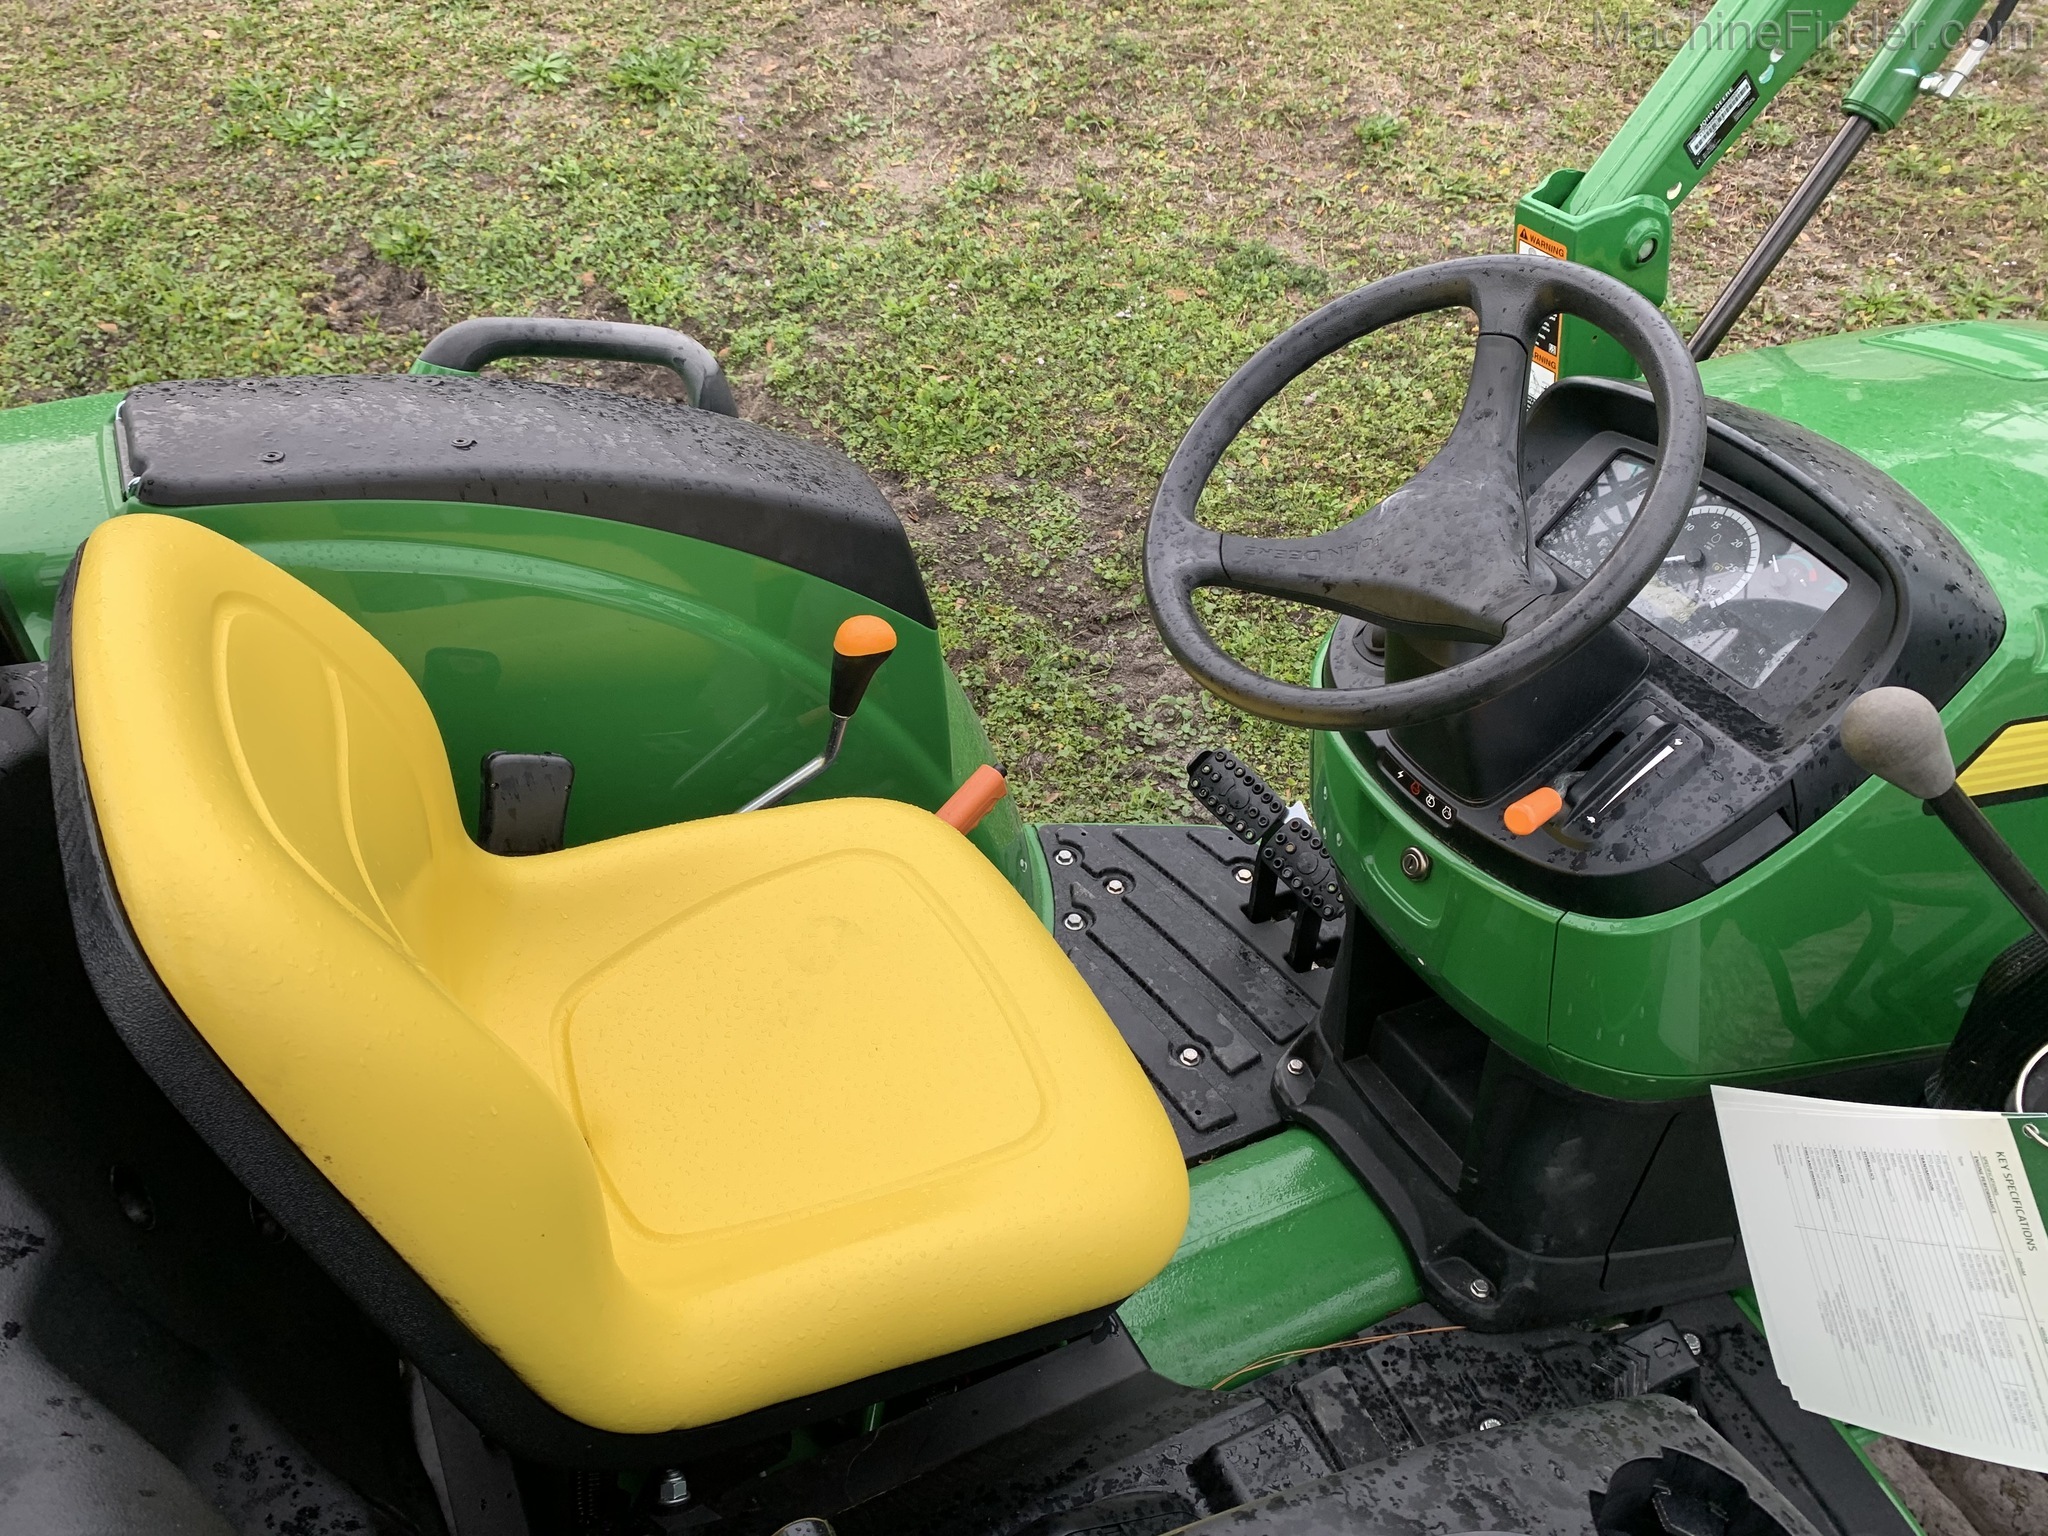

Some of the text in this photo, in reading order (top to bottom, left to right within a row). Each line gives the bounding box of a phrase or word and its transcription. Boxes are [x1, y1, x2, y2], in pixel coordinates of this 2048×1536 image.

[1700, 110, 1715, 129] JOHN
[1715, 87, 1734, 110] DEERE
[1530, 234, 1565, 258] WARNING
[1534, 351, 1556, 370] RNING
[1684, 523, 1695, 532] 10
[1710, 521, 1721, 530] 15
[1731, 538, 1743, 548] 20
[1725, 563, 1738, 573] 25
[1919, 1154, 1934, 1191] TRANSMISSION
[1973, 1155, 1996, 1213] ENGINE PERFORMANCE
[1982, 1156, 1999, 1195] SPECIFICATIONS
[1996, 1151, 2009, 1171] KEY
[2003, 1173, 2037, 1252] SPECIFICATIONS
